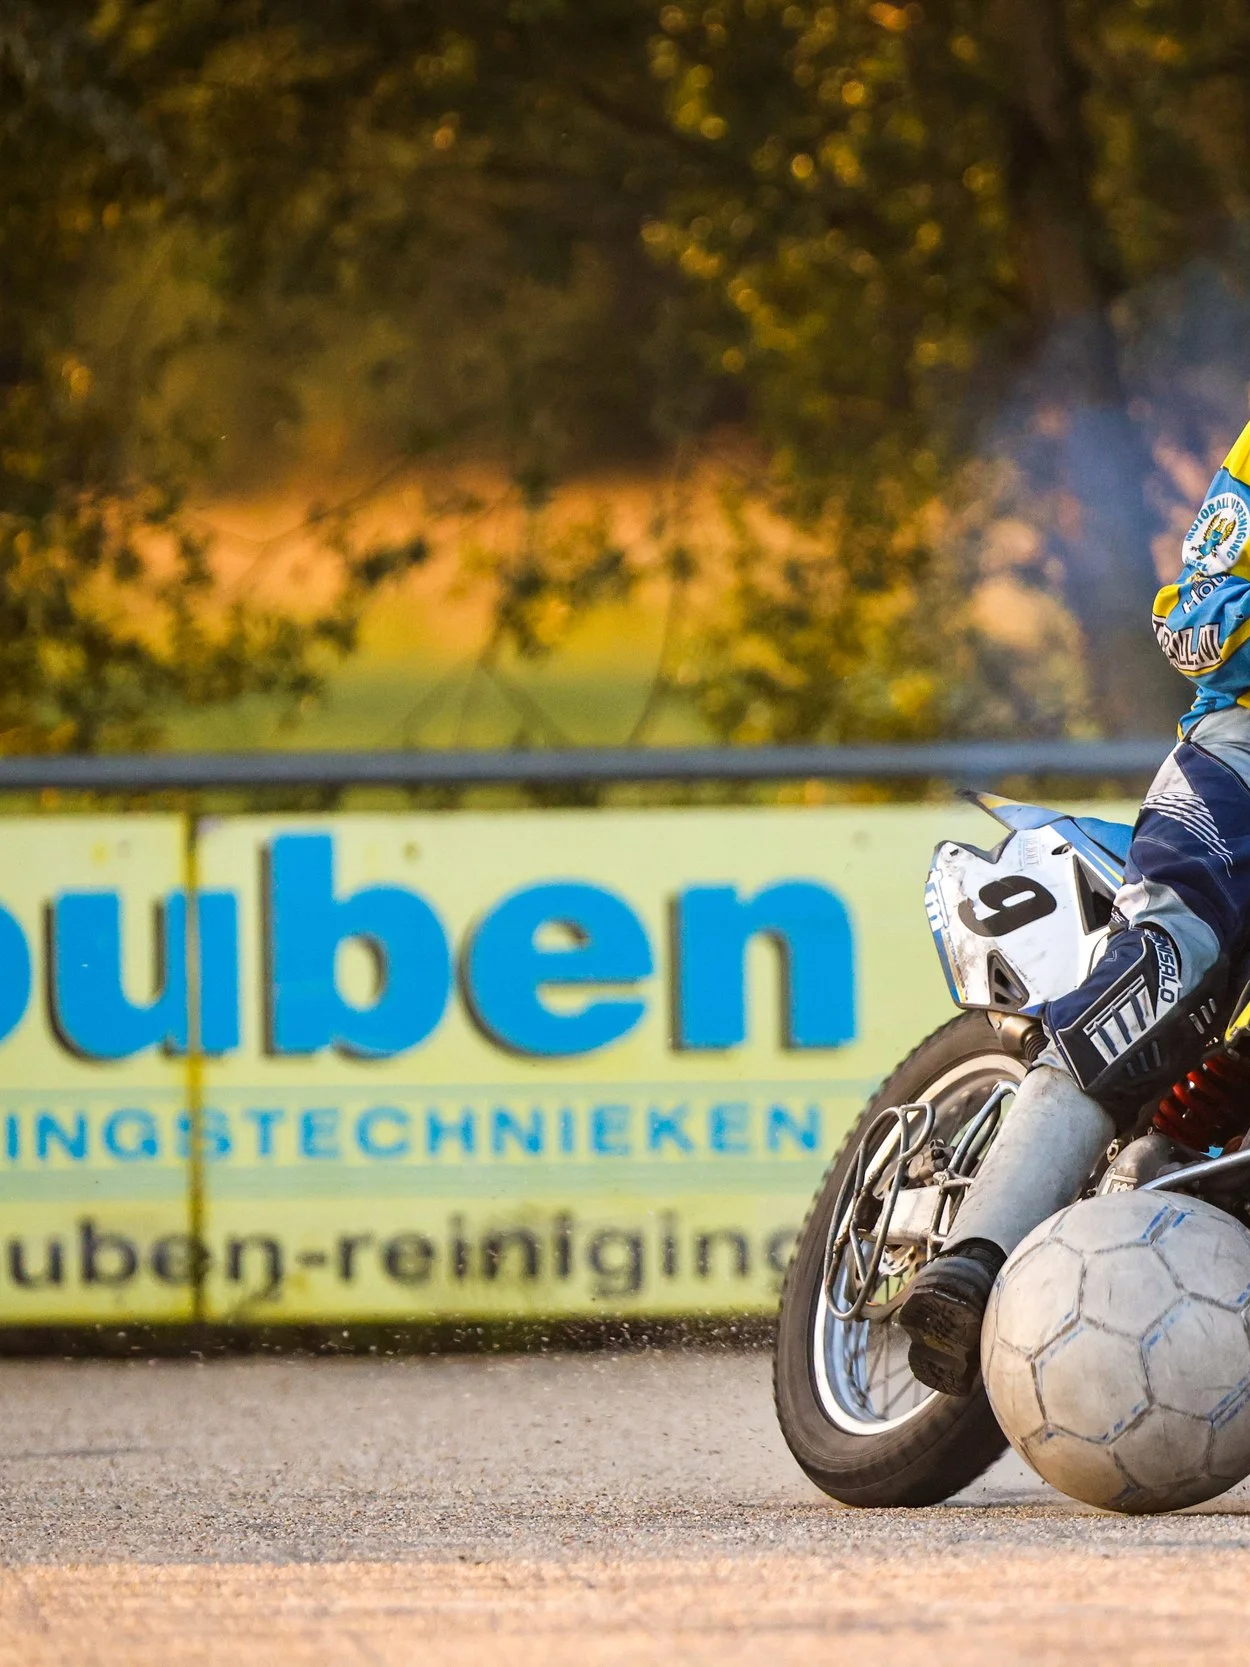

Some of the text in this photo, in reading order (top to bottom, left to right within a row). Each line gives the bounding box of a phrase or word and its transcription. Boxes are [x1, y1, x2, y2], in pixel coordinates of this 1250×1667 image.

[1226, 497, 1249, 561] VERENIGING
[957, 875, 1058, 938] 9
[0, 832, 858, 1060] uben
[5, 1103, 822, 1163] INGSTECHNIEKEN
